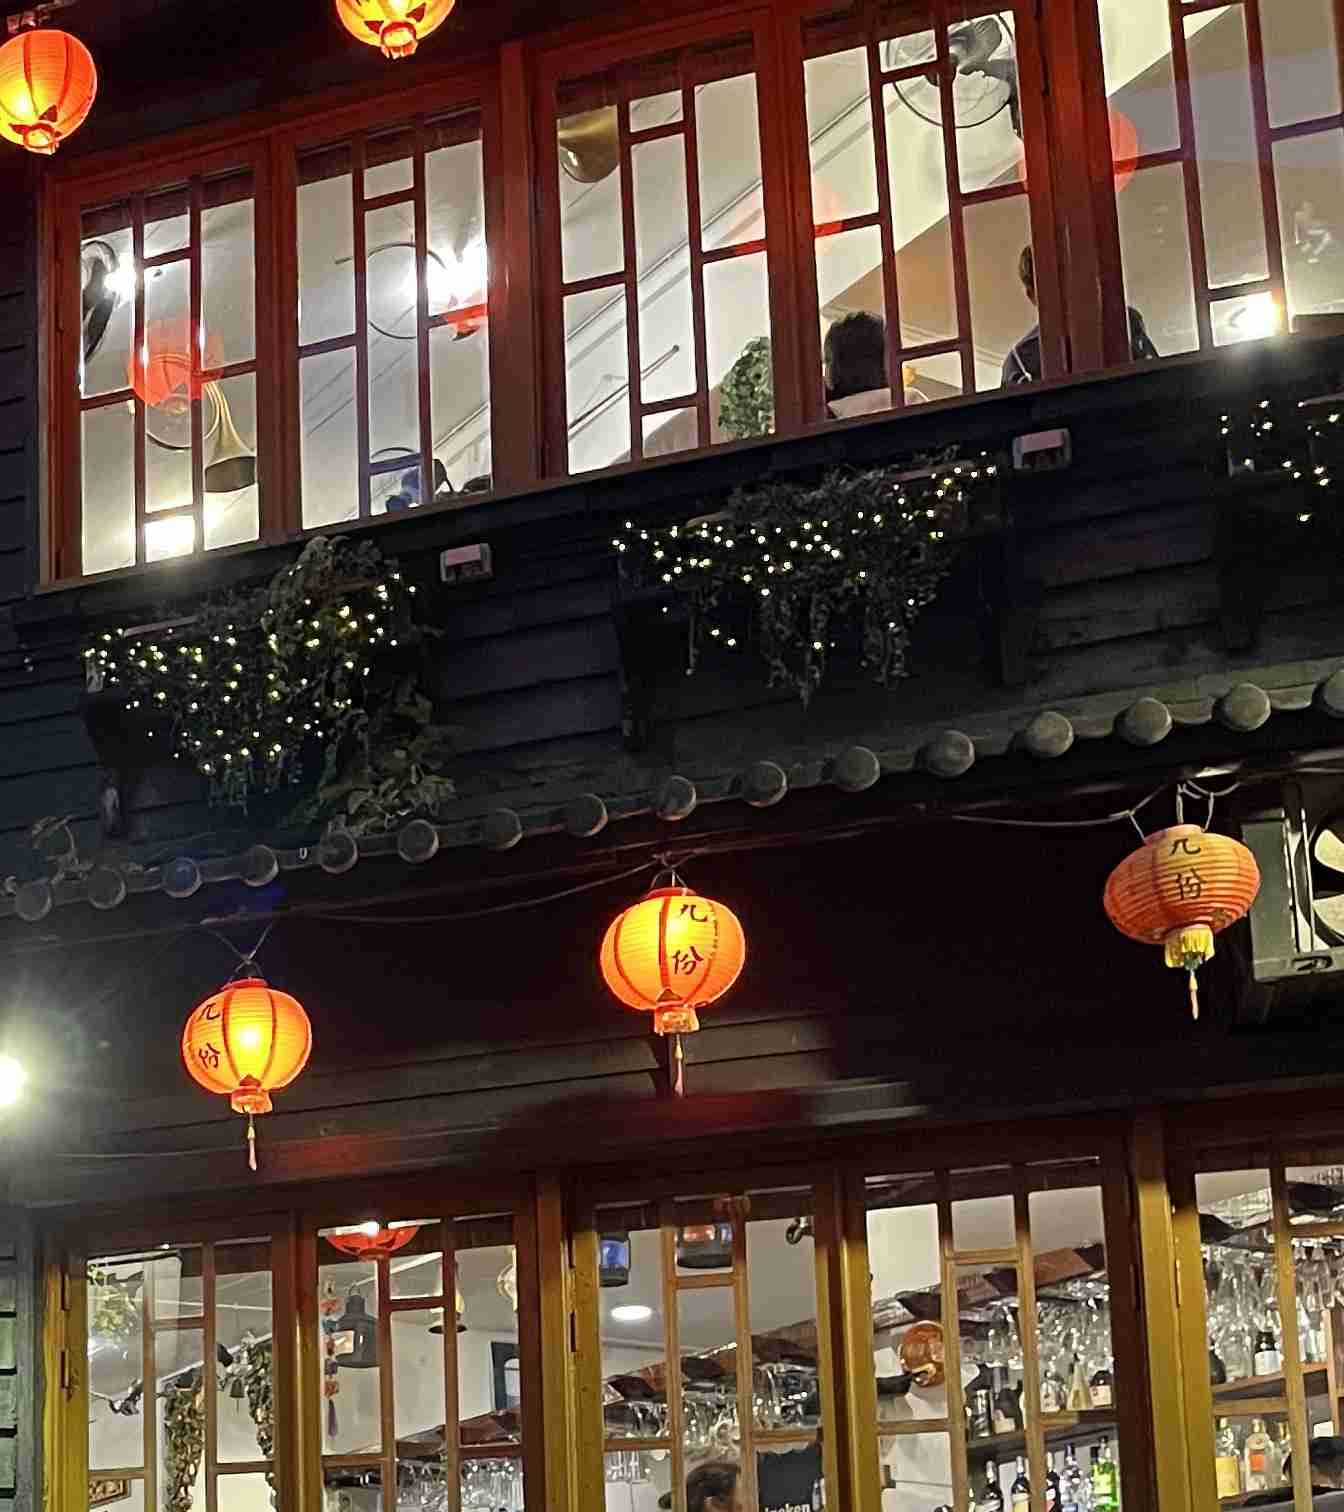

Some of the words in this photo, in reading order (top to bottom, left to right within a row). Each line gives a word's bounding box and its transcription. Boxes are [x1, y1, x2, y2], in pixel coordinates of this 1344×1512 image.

[1170, 837, 1208, 900] 九份
[672, 903, 708, 975] 九份
[198, 1002, 221, 1069] 九份
